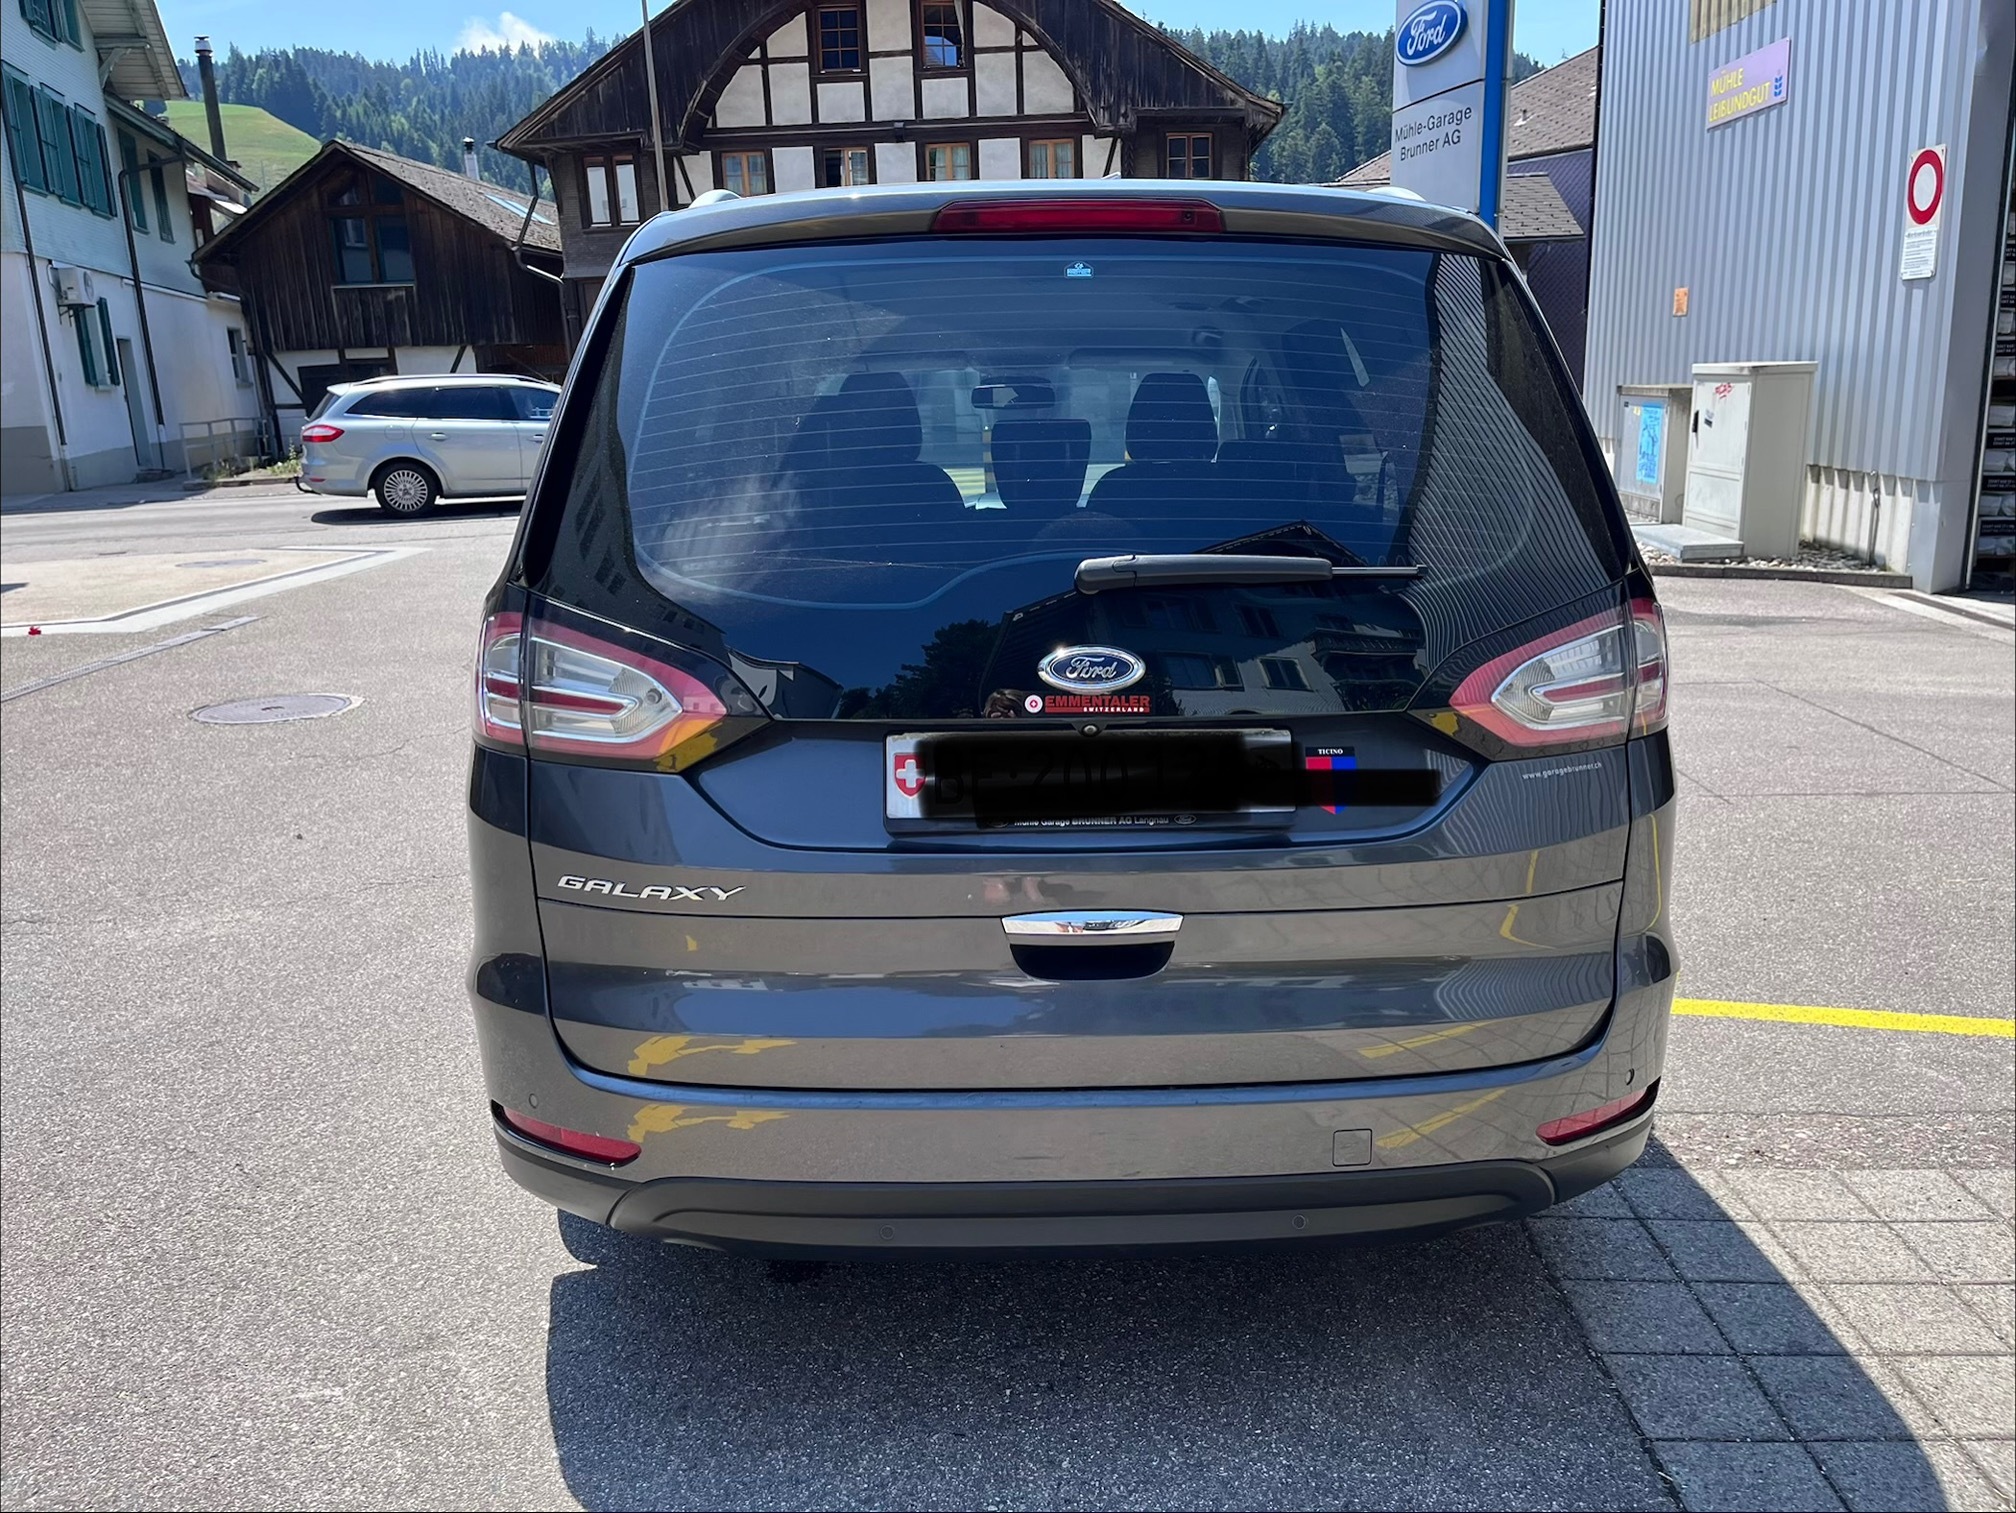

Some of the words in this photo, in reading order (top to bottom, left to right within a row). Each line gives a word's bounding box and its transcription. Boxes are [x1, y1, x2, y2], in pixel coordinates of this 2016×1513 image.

[1407, 10, 1447, 56] Ford
[1711, 67, 1744, 97] MÜHLE
[1709, 81, 1771, 122] LEIBUNDGUT
[1394, 106, 1472, 143] Mühle-Garage
[1400, 138, 1440, 161] Brunner
[1442, 129, 1461, 147] AG
[1065, 656, 1118, 679] Ford
[1044, 695, 1150, 708] EMMENTALER
[1082, 706, 1145, 714] SWITZERLAND
[1522, 761, 1602, 780] www.garagebrunner.ch
[1072, 816, 1117, 826] BRUNNER
[1118, 815, 1133, 825] AG
[1134, 815, 1169, 826] Langnau
[557, 874, 747, 901] GALAXY
